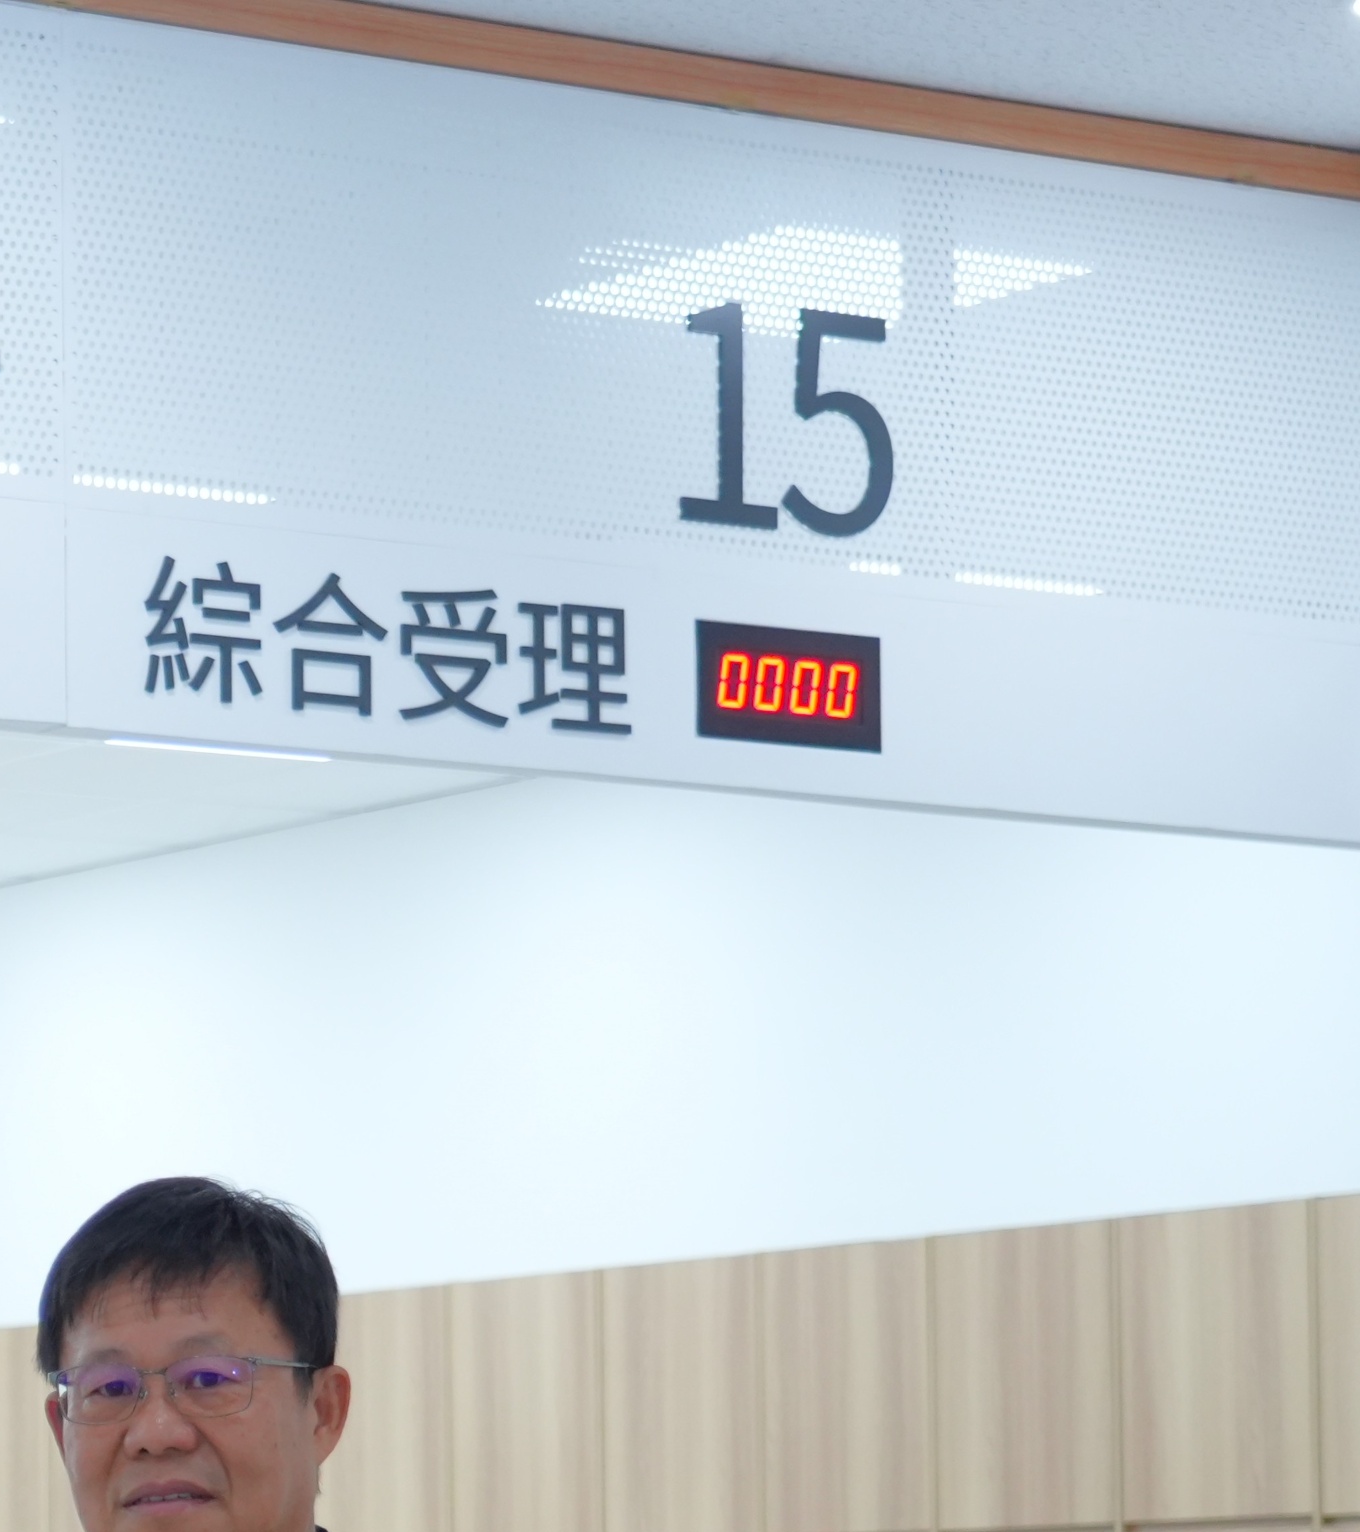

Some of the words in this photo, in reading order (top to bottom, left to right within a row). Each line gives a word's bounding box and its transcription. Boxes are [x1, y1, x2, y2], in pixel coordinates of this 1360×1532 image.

[679, 302, 895, 537] 15
[144, 555, 632, 737] 綜合受理
[716, 651, 860, 719] 0000
